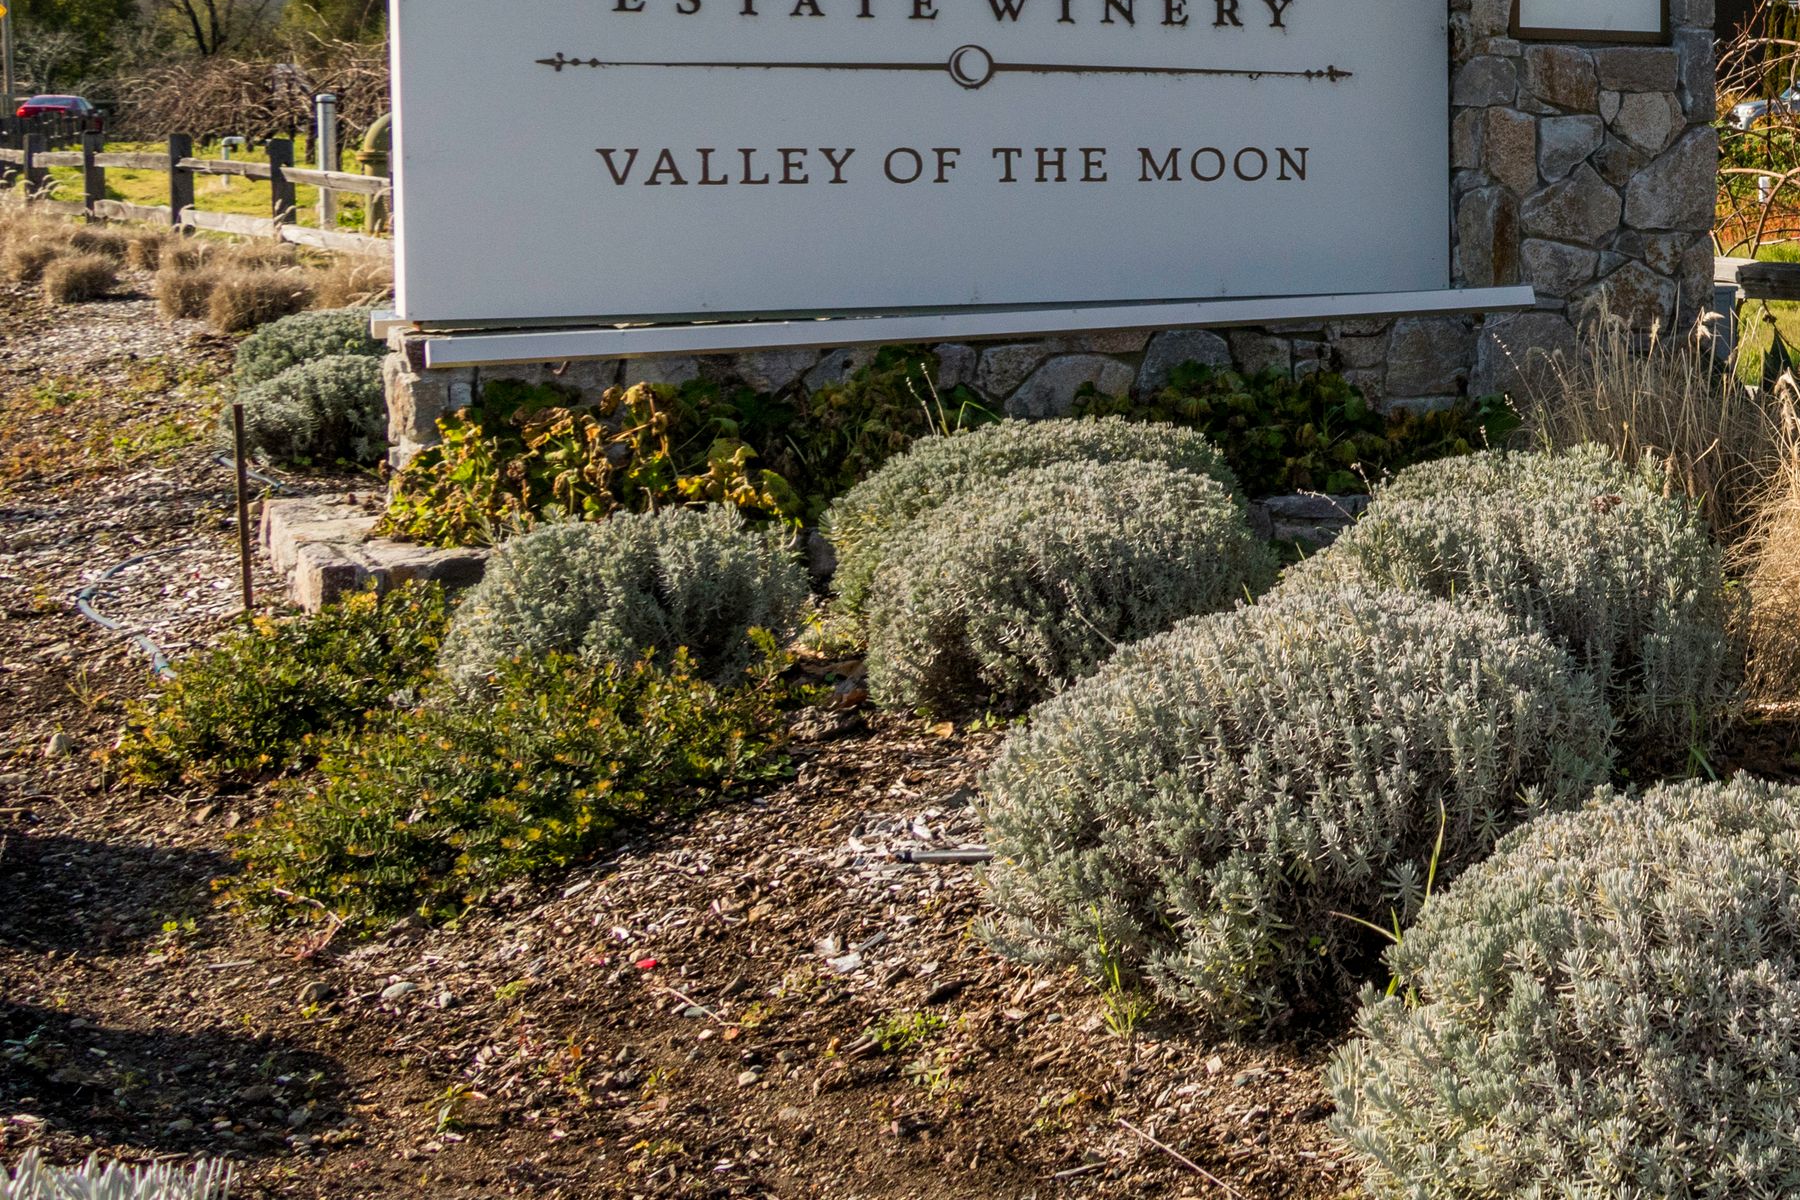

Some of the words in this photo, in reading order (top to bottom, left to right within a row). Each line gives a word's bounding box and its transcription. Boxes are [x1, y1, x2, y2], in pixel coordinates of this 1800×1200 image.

[595, 147, 857, 186] VALLEY
[884, 147, 962, 185] OF
[992, 147, 1108, 184] THE
[1137, 146, 1311, 183] MOON
